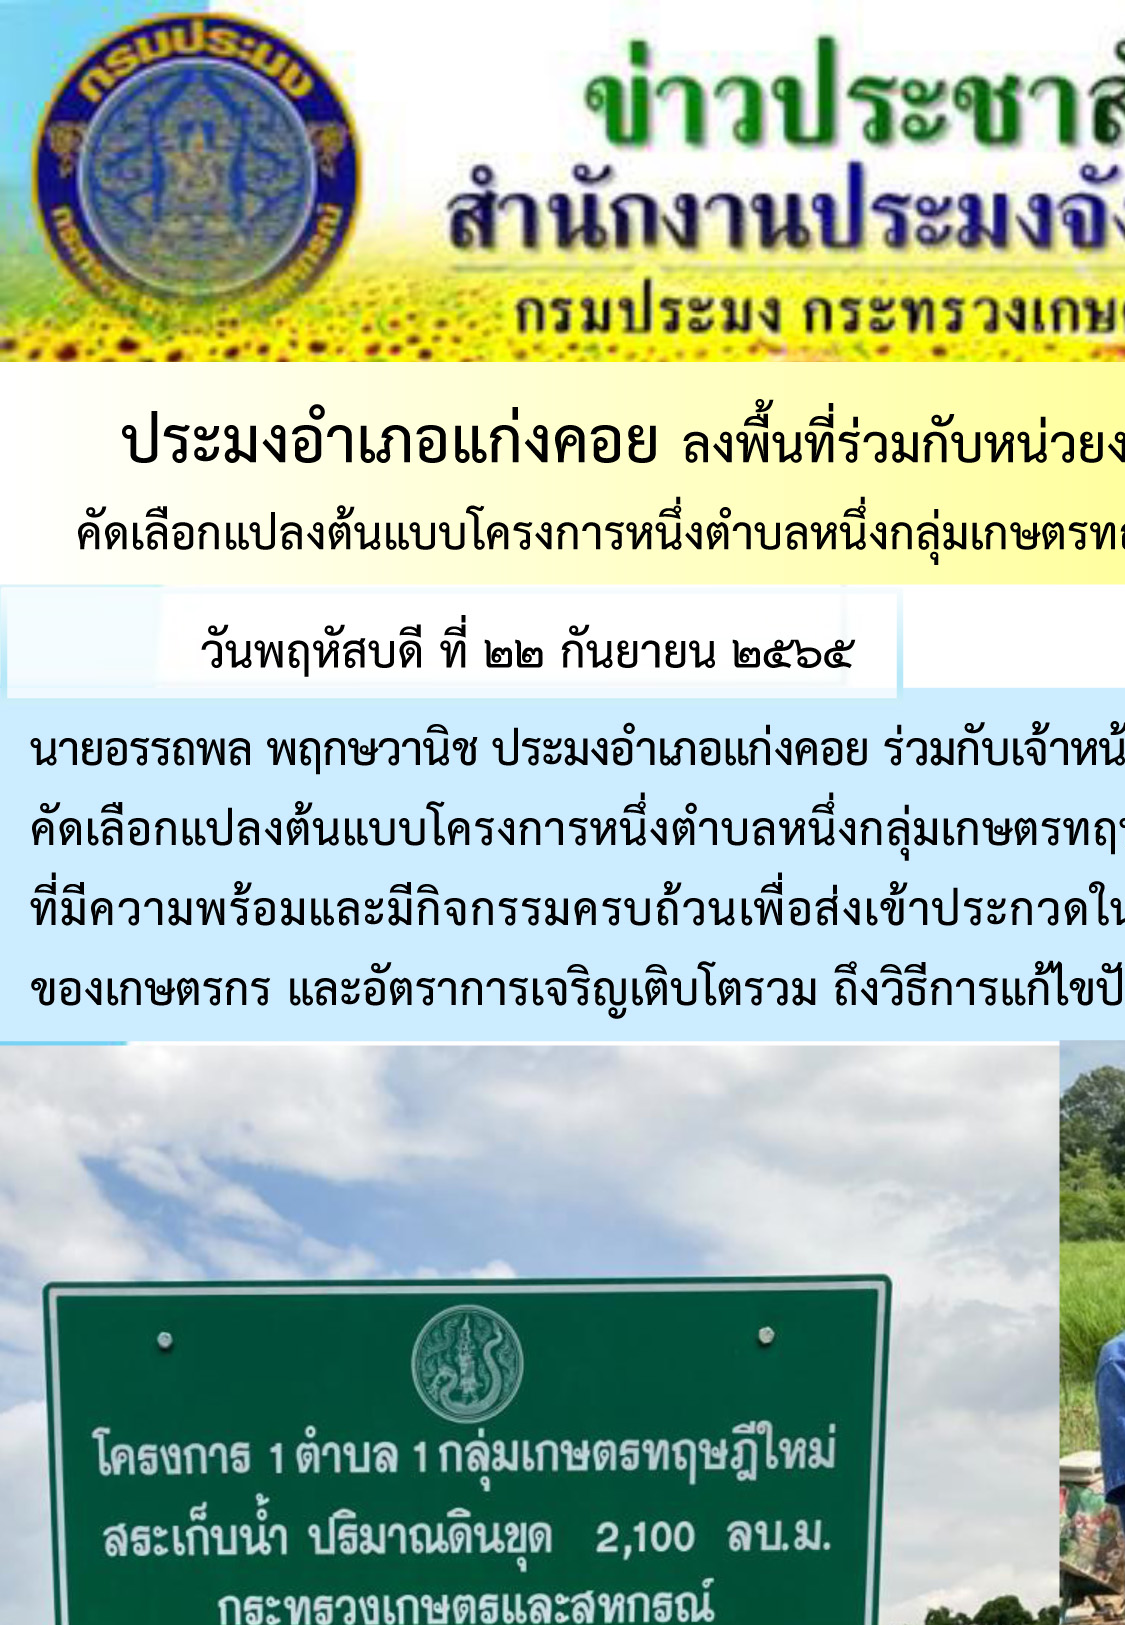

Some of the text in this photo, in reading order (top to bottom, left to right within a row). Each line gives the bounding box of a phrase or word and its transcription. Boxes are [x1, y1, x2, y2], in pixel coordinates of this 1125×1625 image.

[92, 1420, 836, 1492] โครงการ 1 ตำบล 1 กลุ่มเกษตรทฤษฎีใหม่
[103, 1493, 831, 1572] สระเก็บน้ำ ปริมาณดินขุด 2,100 ลบ.ม.
